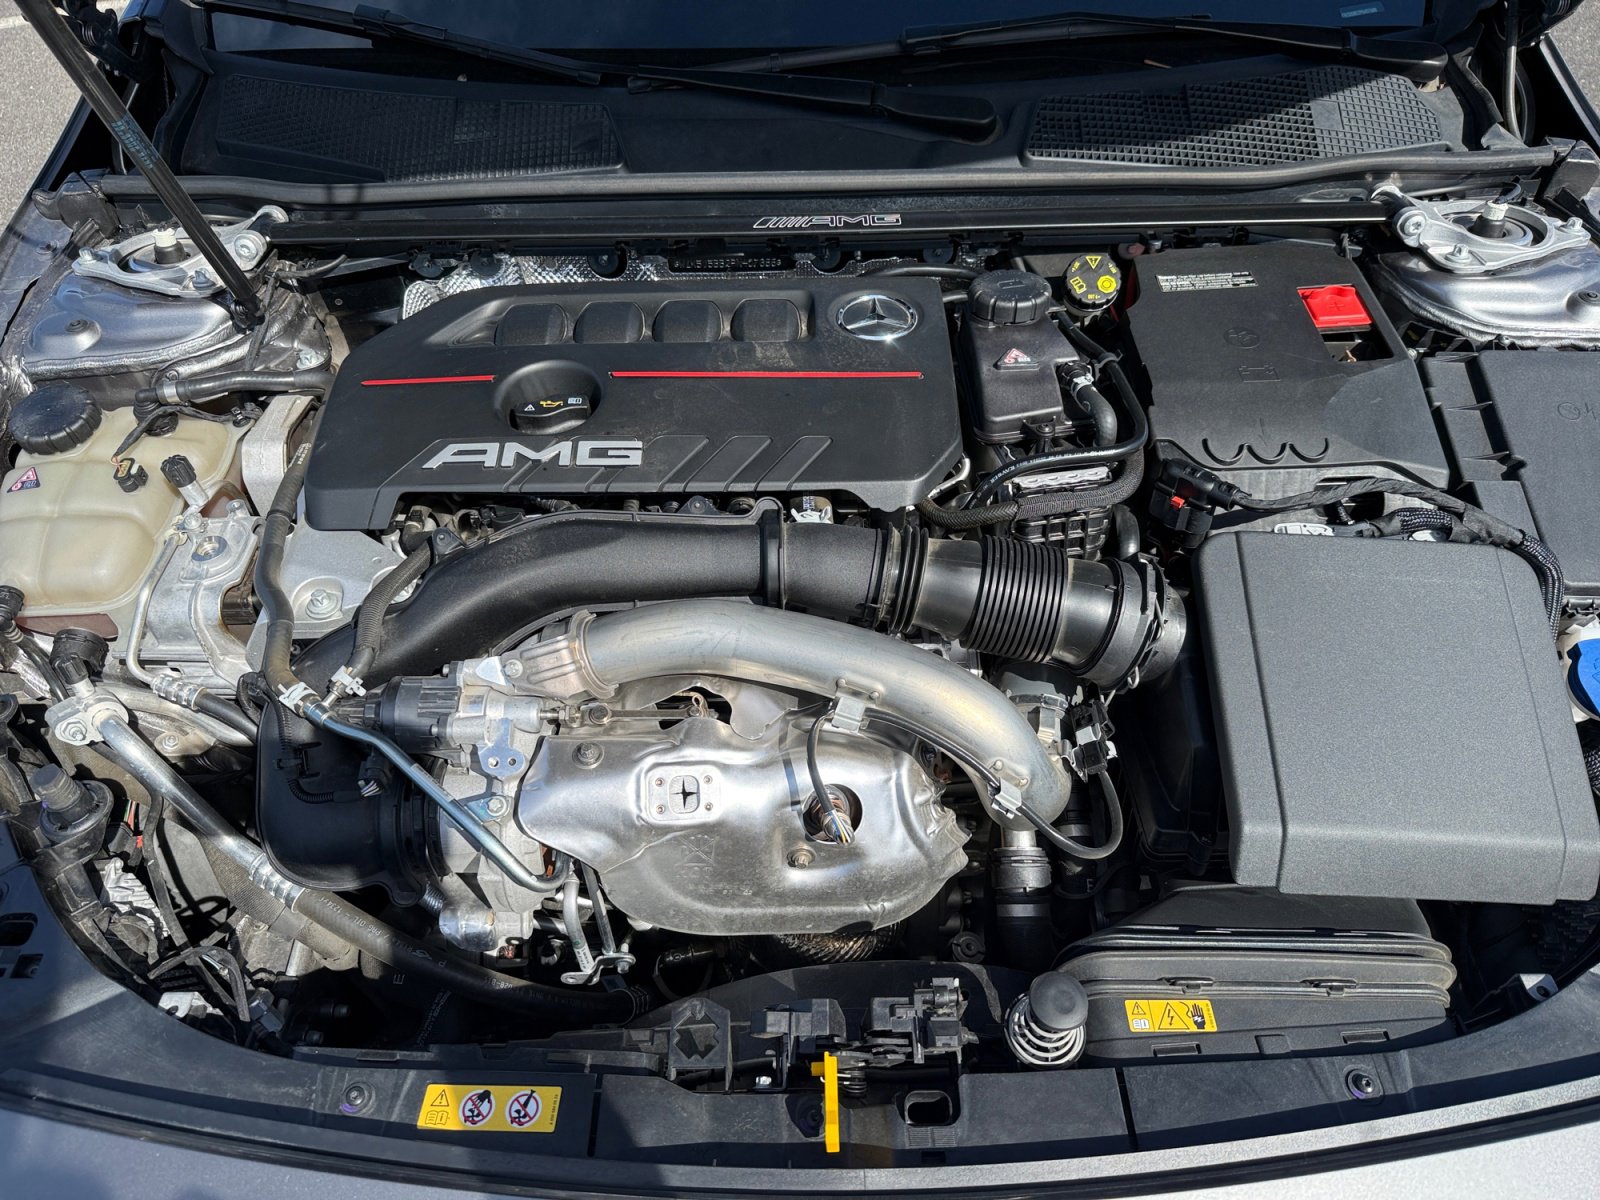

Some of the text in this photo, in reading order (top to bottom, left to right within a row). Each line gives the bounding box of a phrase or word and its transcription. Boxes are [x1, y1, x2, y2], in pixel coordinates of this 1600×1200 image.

[802, 214, 902, 227] AMG
[421, 440, 643, 469] AMG
[353, 916, 367, 928] OIL
